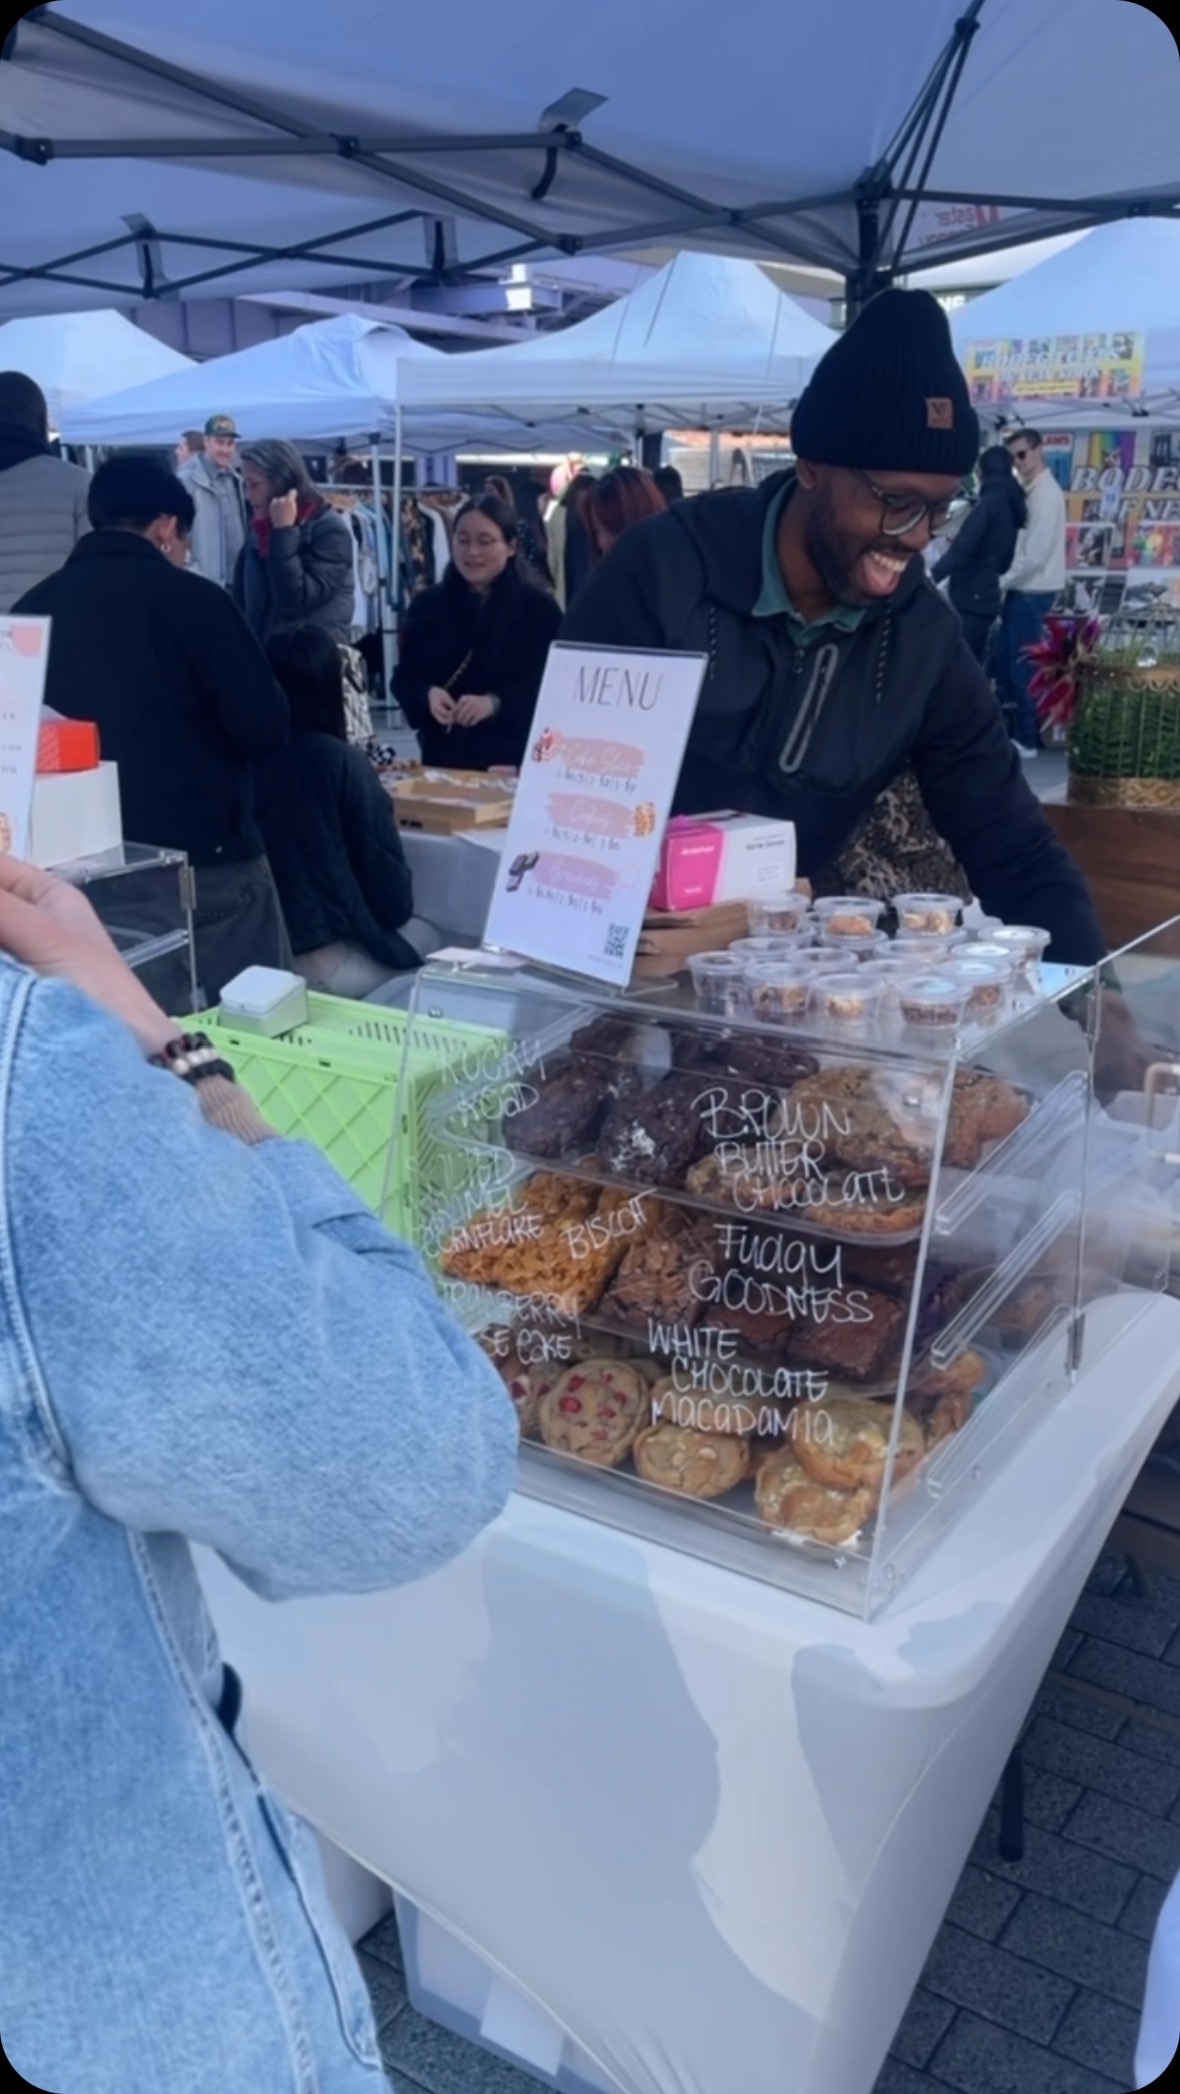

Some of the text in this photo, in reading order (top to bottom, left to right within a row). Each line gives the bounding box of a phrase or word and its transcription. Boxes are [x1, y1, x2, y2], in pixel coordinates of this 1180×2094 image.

[1070, 466, 1180, 492] BODE
[572, 665, 663, 711] MENU
[690, 1087, 851, 1139] BROWN
[713, 1139, 826, 1179] BUTTER
[730, 1166, 905, 1213] CHOCOLATE
[688, 1260, 874, 1322] GOODNESS
[516, 1327, 573, 1365] CAKE
[648, 1318, 740, 1358] WHITE
[671, 1355, 829, 1402] CHOCOLATE
